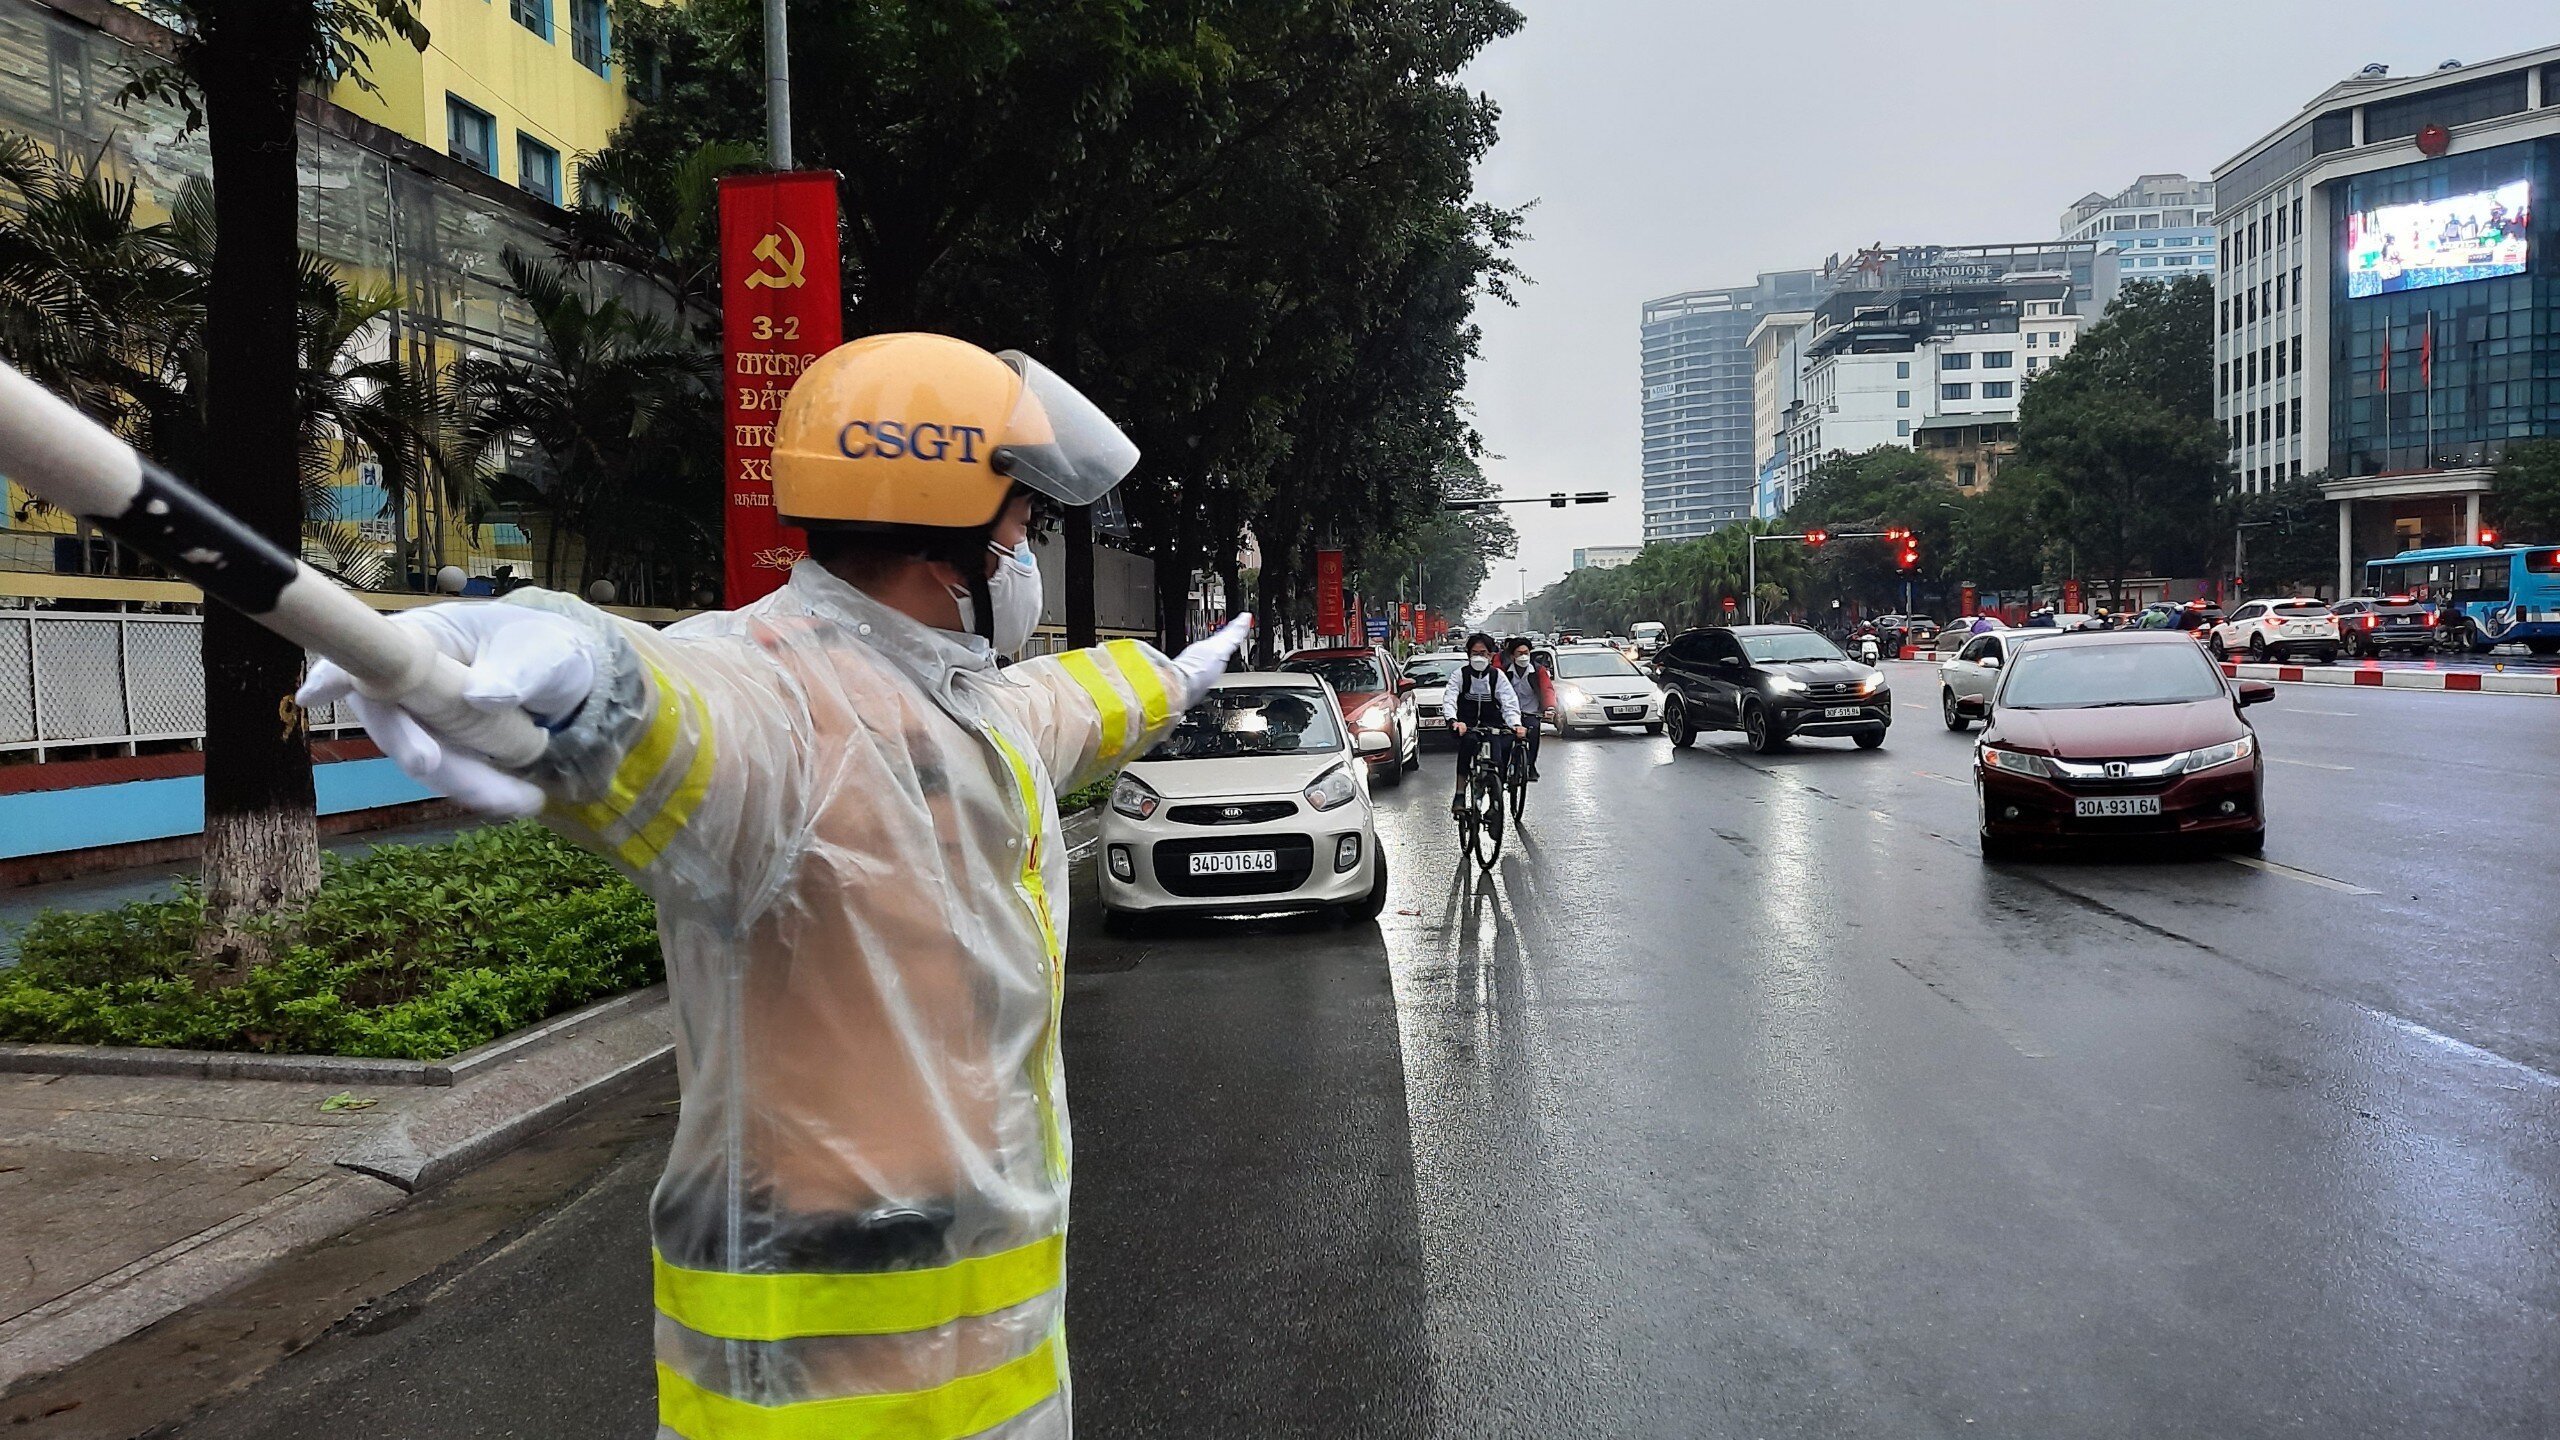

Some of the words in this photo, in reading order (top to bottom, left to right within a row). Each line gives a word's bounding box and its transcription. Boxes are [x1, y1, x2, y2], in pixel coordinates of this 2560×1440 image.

[1911, 264, 1992, 278] GRANDIOSE
[751, 315, 800, 340] 3-2
[838, 420, 986, 463] CSGT
[2078, 799, 2158, 815] 30A-931.64
[1192, 853, 1273, 873] 34D-016.48
